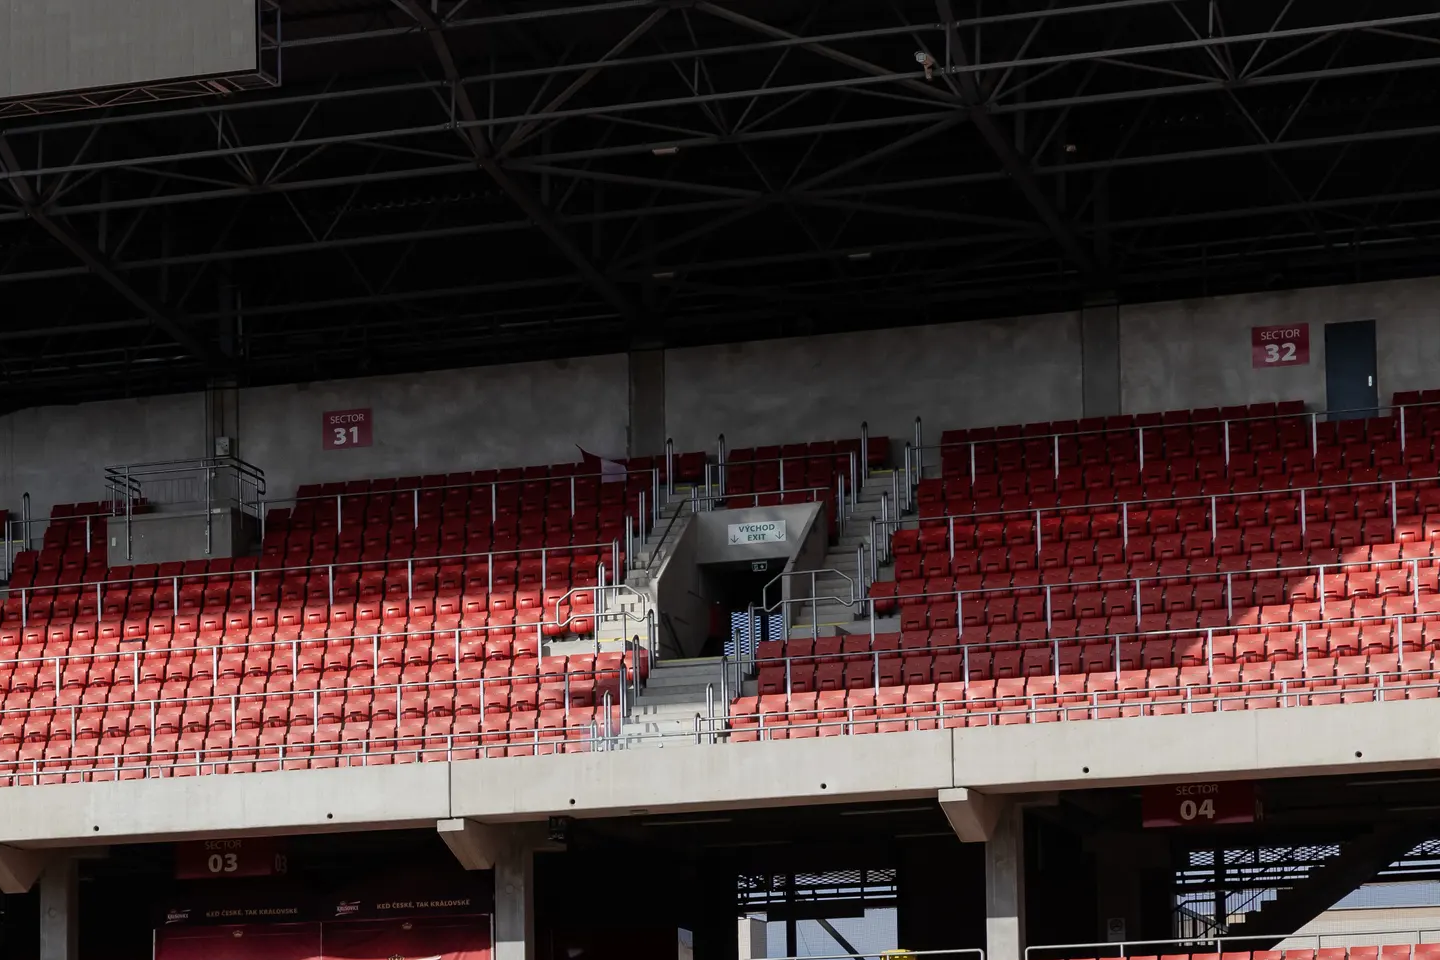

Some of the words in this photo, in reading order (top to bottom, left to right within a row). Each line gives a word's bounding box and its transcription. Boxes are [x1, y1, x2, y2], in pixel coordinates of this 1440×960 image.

[1260, 329, 1300, 341] SECTOR
[1265, 342, 1297, 363] 32
[330, 413, 365, 424] SECTOR
[333, 426, 359, 445] 31
[739, 524, 775, 533] VÝCHOD
[1175, 784, 1219, 796] SECTOR
[1179, 799, 1216, 820] 04
[204, 840, 242, 850] SECTOR
[208, 853, 239, 873] 03
